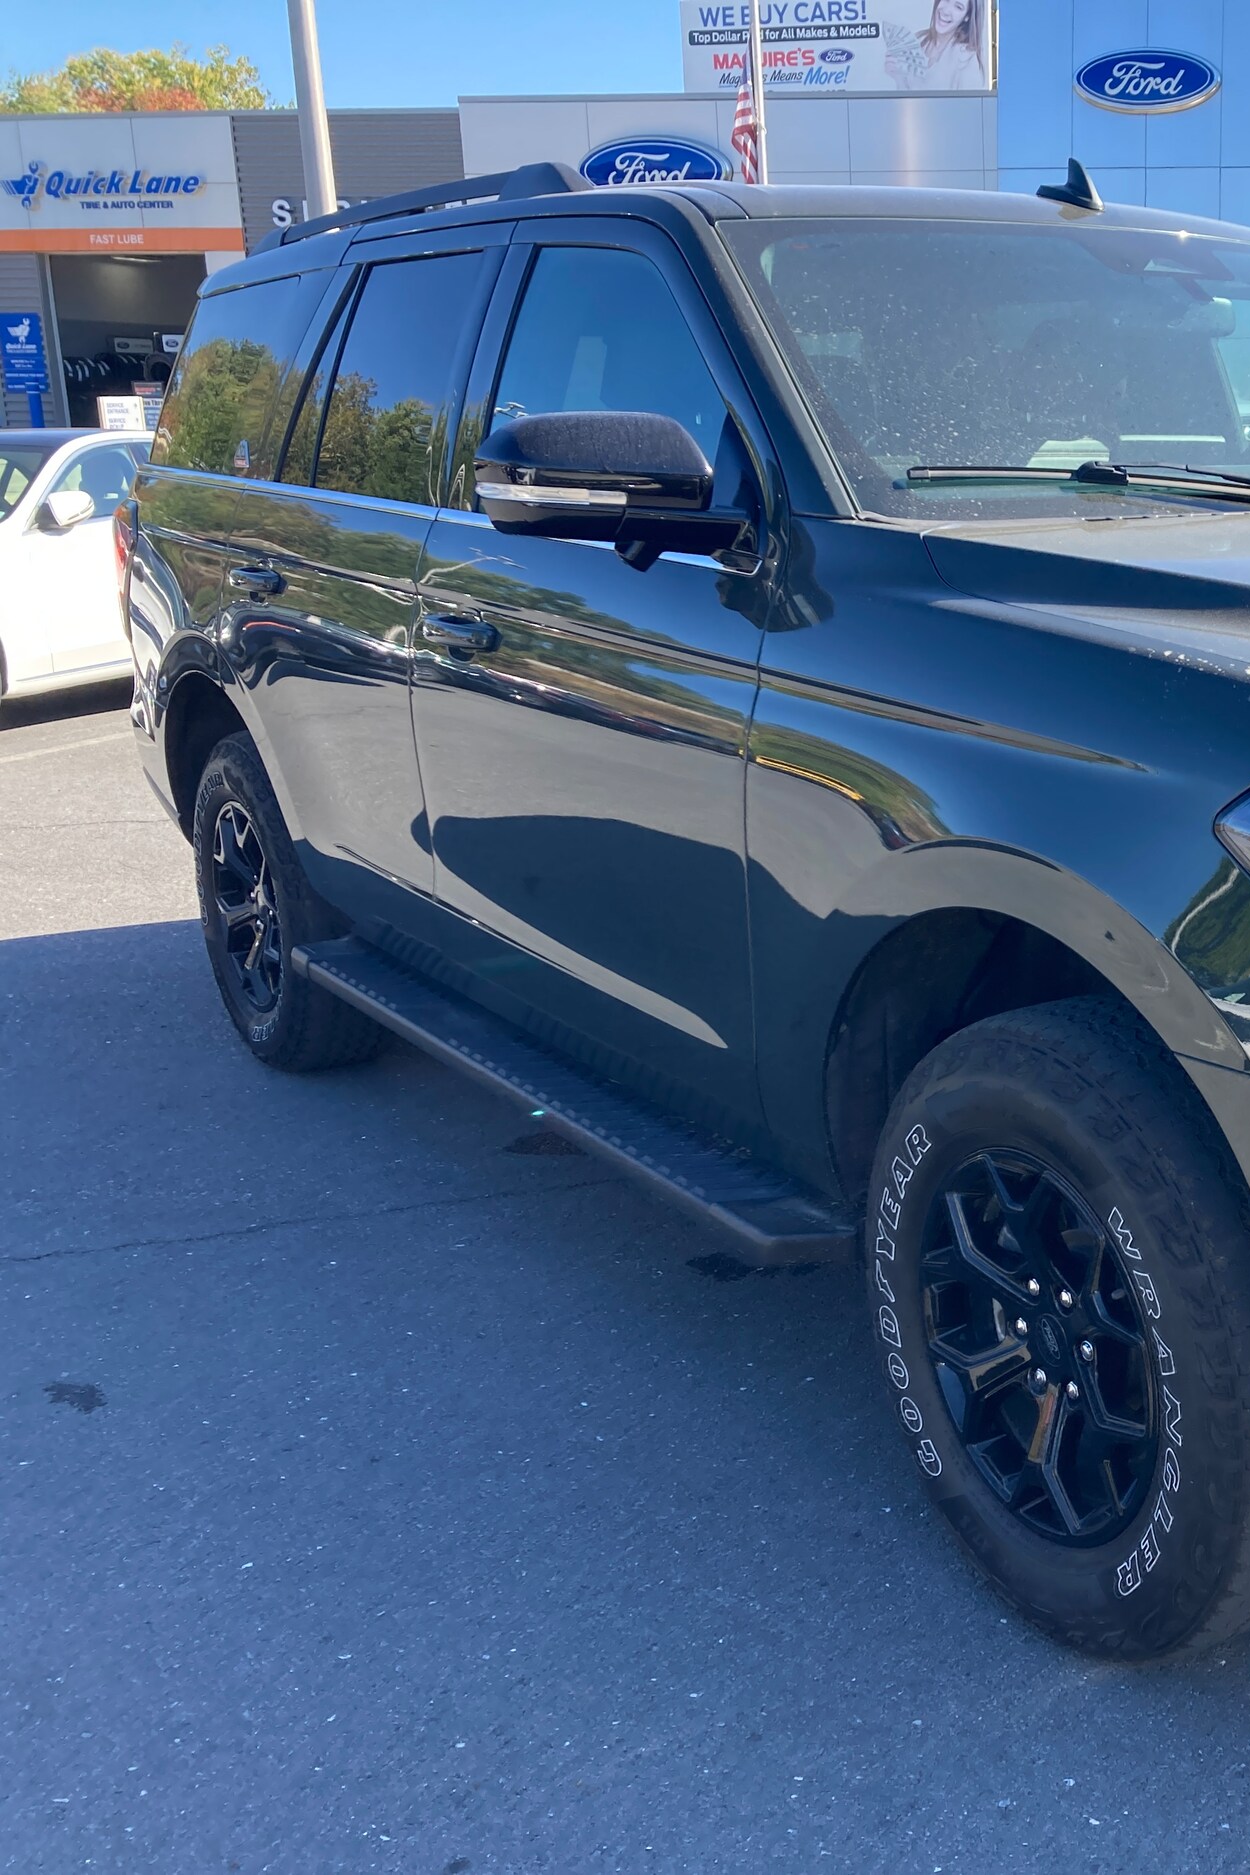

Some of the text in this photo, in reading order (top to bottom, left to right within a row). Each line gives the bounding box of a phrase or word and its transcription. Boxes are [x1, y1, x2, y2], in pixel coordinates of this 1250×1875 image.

[699, 7, 734, 27] WE
[794, 0, 867, 23] CARS!
[693, 32, 711, 44] Top
[712, 31, 740, 43] Dollar
[765, 29, 780, 40] for
[781, 28, 795, 39] All
[796, 27, 828, 38] Makes
[829, 27, 838, 37] &
[839, 25, 877, 37] Models
[770, 69, 804, 82] Means
[803, 65, 851, 86] More!
[1104, 60, 1186, 96] Ford
[608, 152, 692, 185] Ford
[45, 170, 201, 199] Quick Lane
[80, 201, 174, 209] TIRE & AUTO CENTER
[90, 234, 144, 245] FAST LUBE
[874, 1123, 942, 1477] GOODYEAR
[1108, 1206, 1183, 1597] WRANGLER
